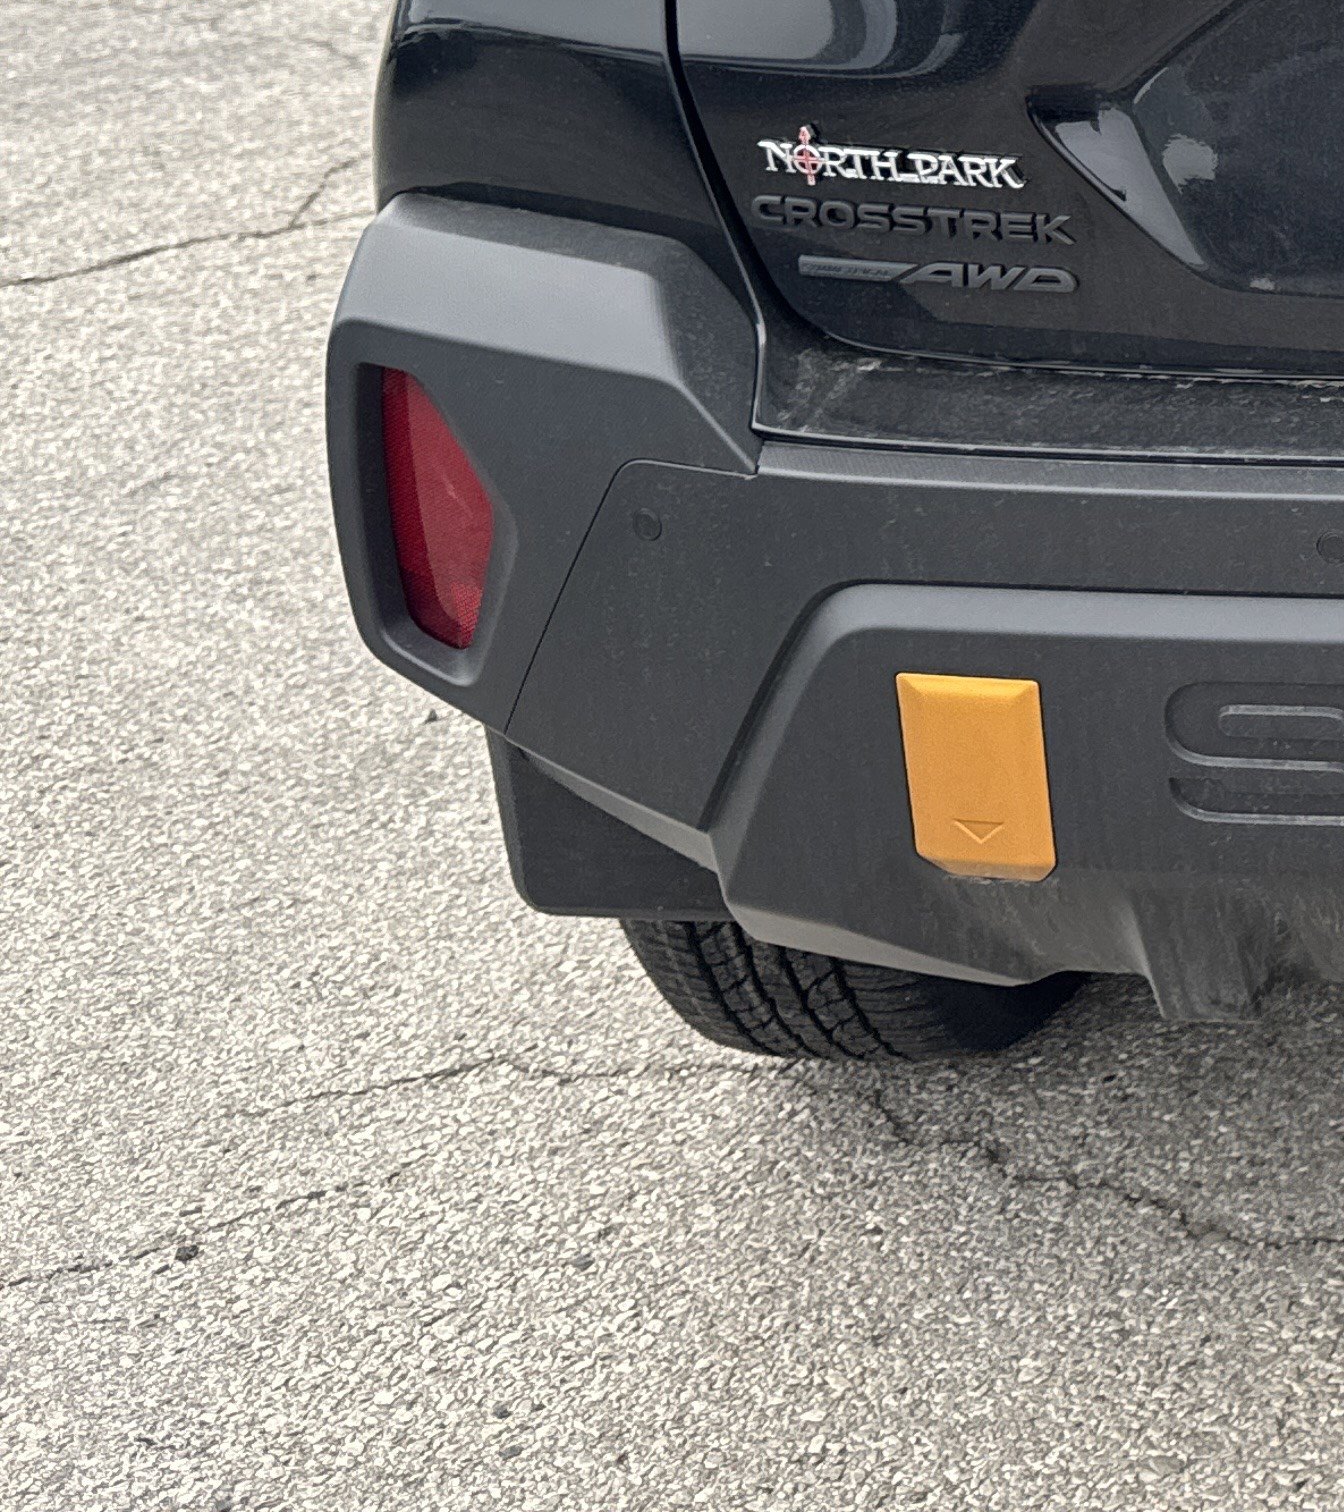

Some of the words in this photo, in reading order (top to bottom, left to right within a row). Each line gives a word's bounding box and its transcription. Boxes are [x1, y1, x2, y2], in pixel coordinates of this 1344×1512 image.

[757, 133, 901, 185] NORTH
[905, 153, 1025, 189] PARK
[752, 195, 1076, 245] CROSSTREK
[899, 262, 1077, 293] AWD
